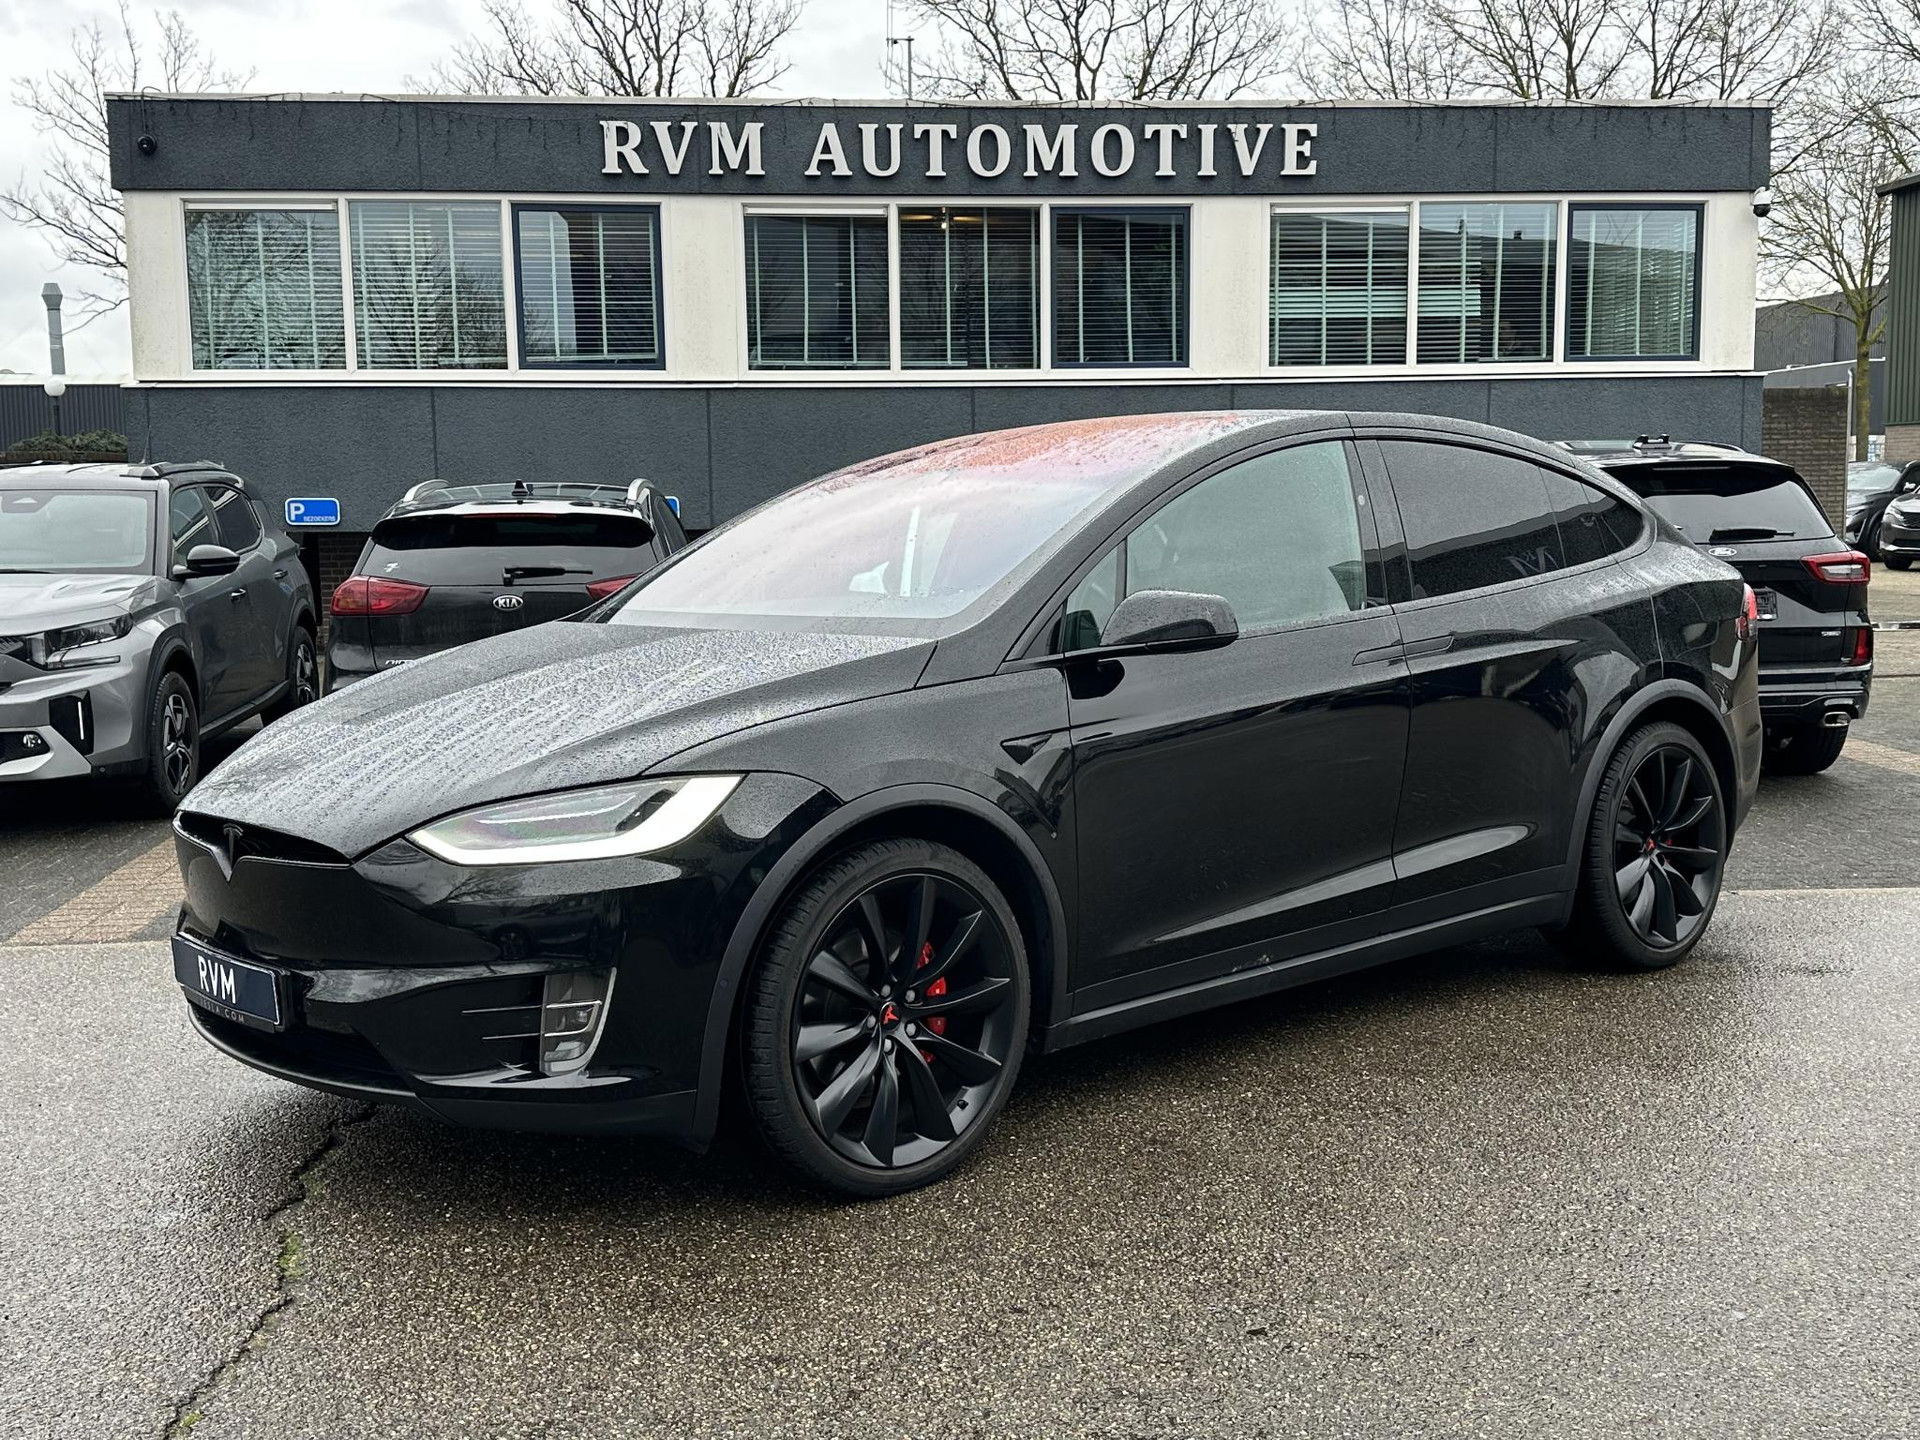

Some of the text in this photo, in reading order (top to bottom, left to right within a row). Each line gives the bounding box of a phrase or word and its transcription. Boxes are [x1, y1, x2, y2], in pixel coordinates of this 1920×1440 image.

[600, 120, 1319, 178] RVM AUTOMOTIVE
[290, 503, 305, 521] P
[498, 598, 518, 608] KIA
[198, 955, 236, 1004] RVM
